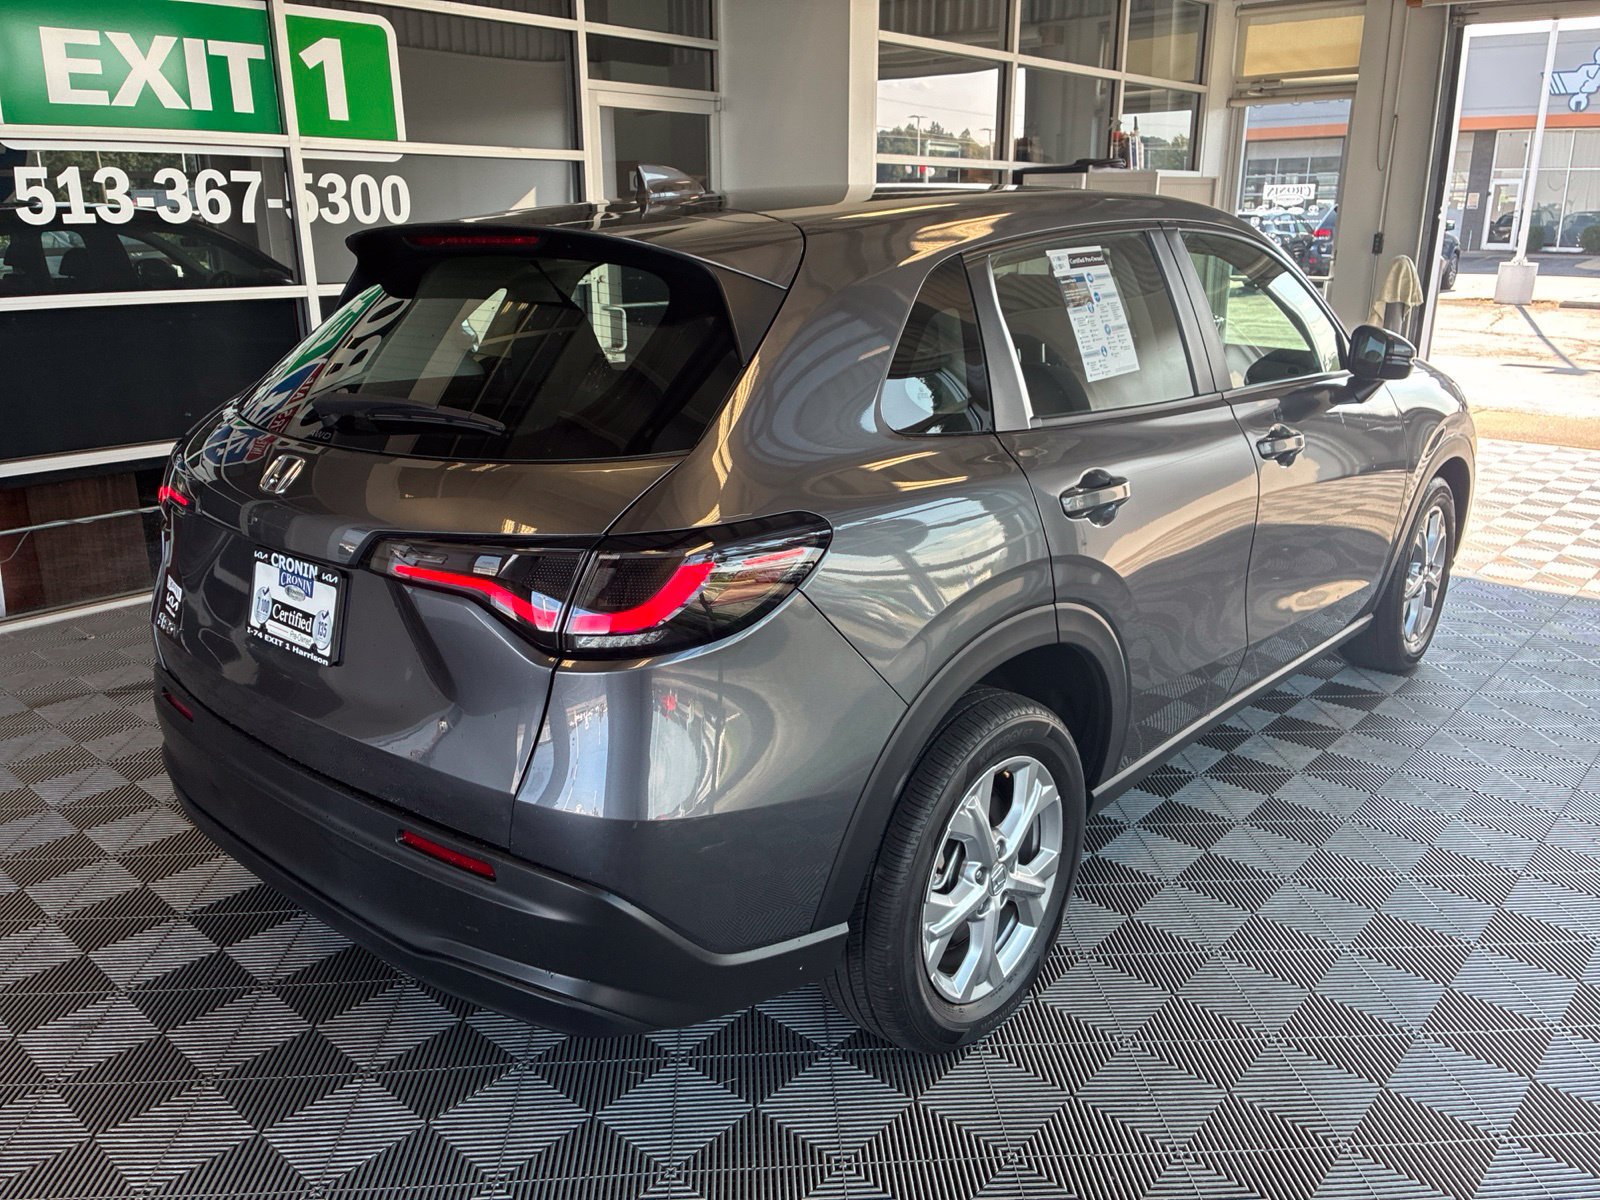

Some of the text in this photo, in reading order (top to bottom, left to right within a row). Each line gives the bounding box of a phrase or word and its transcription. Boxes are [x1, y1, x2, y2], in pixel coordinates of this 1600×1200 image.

[39, 26, 349, 122] EXIT 1
[13, 166, 411, 226] 513-367-5300
[271, 552, 319, 579] CRONIN
[280, 571, 313, 598] CRONIN
[272, 603, 313, 633] Certified
[246, 626, 330, 667] I-74 EXIT 1 Harrison
